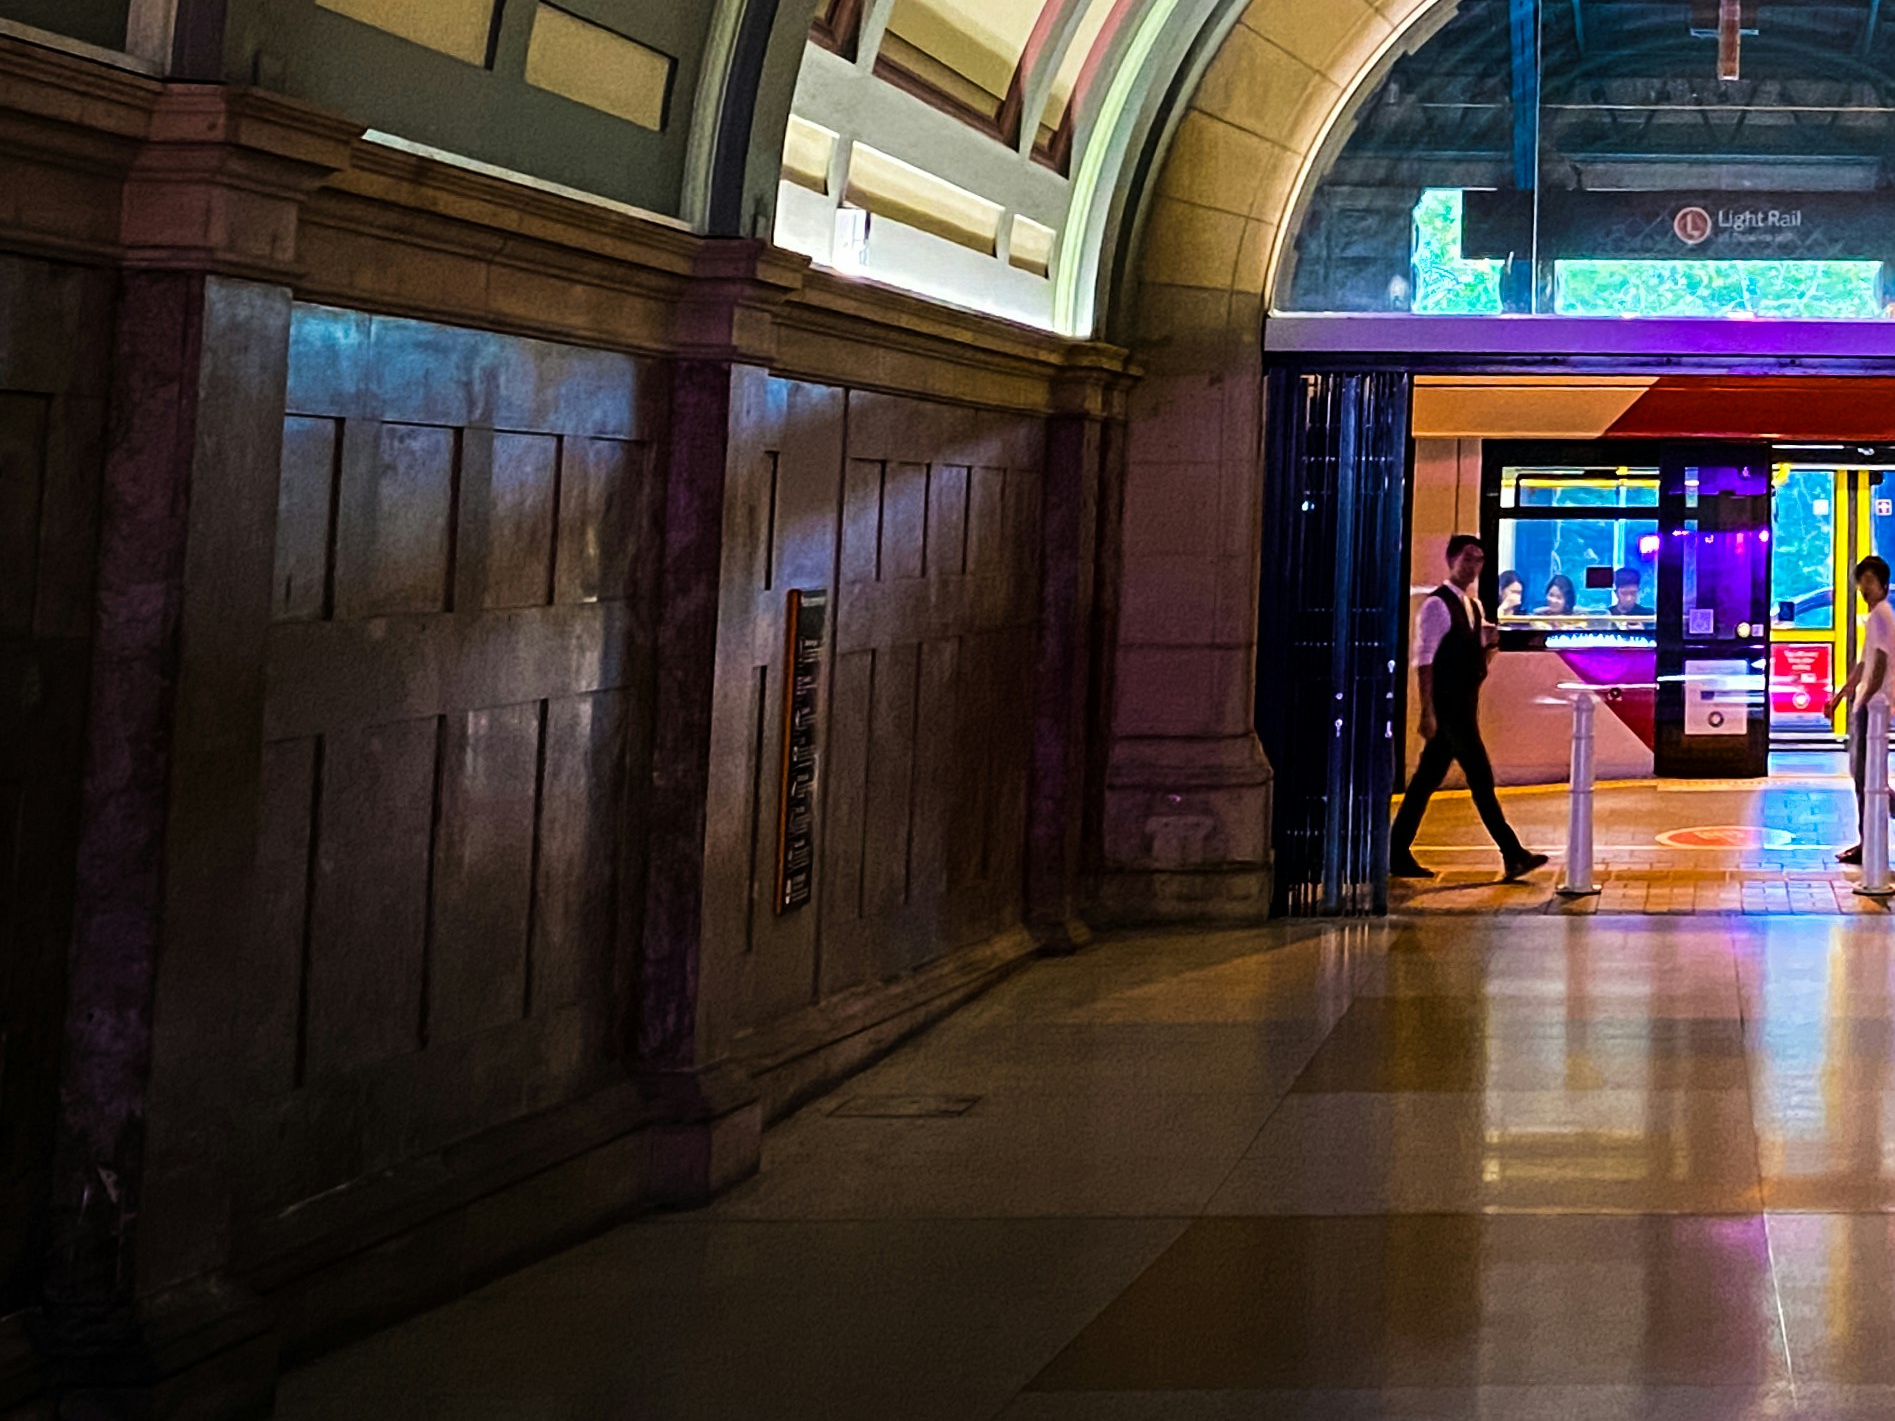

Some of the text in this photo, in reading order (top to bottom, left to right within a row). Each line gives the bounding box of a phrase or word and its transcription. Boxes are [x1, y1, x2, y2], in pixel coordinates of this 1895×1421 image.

[1686, 213, 1701, 236] L
[1718, 210, 1802, 231] Light Rail
